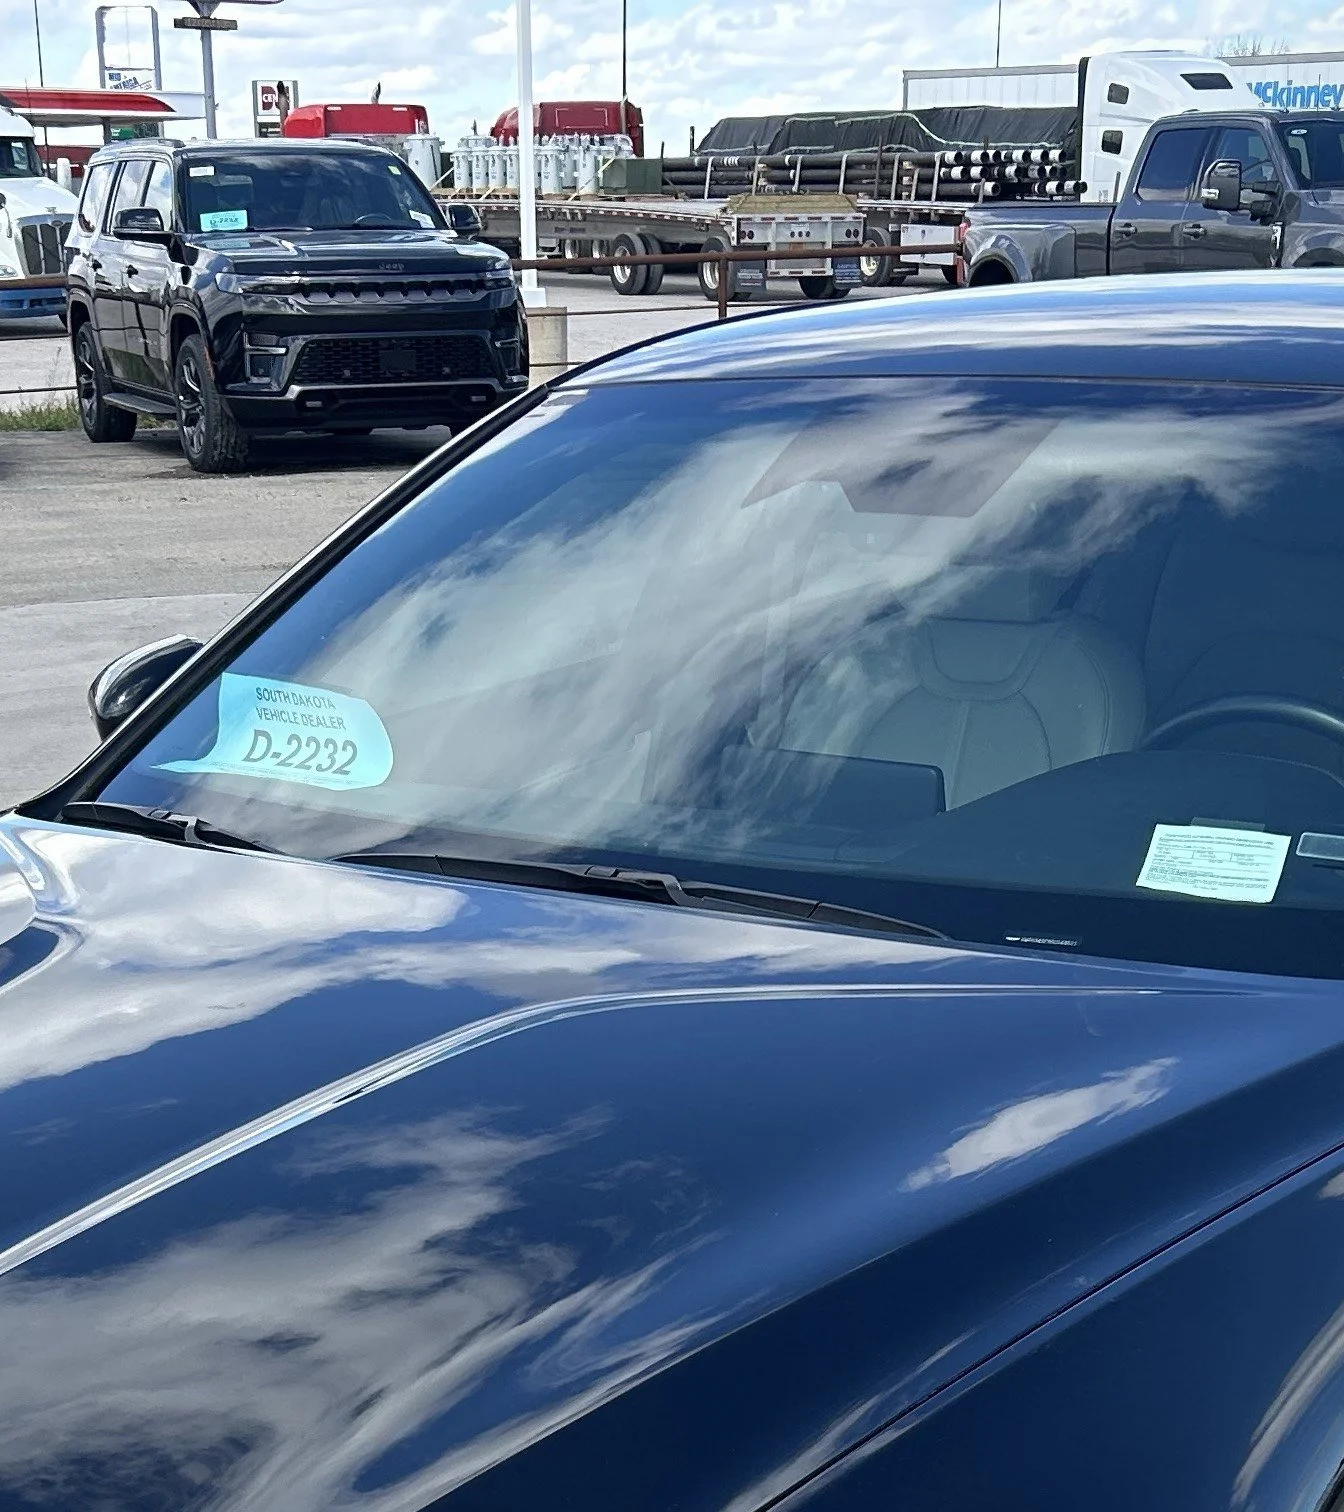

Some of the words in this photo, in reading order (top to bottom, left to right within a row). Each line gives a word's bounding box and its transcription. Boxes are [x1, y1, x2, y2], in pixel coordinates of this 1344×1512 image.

[256, 687, 291, 704] SOUTH
[291, 692, 336, 710] DAKOTA
[256, 707, 300, 725] VEHICLE
[301, 713, 346, 730] DEALER
[242, 729, 358, 776] D-2232
